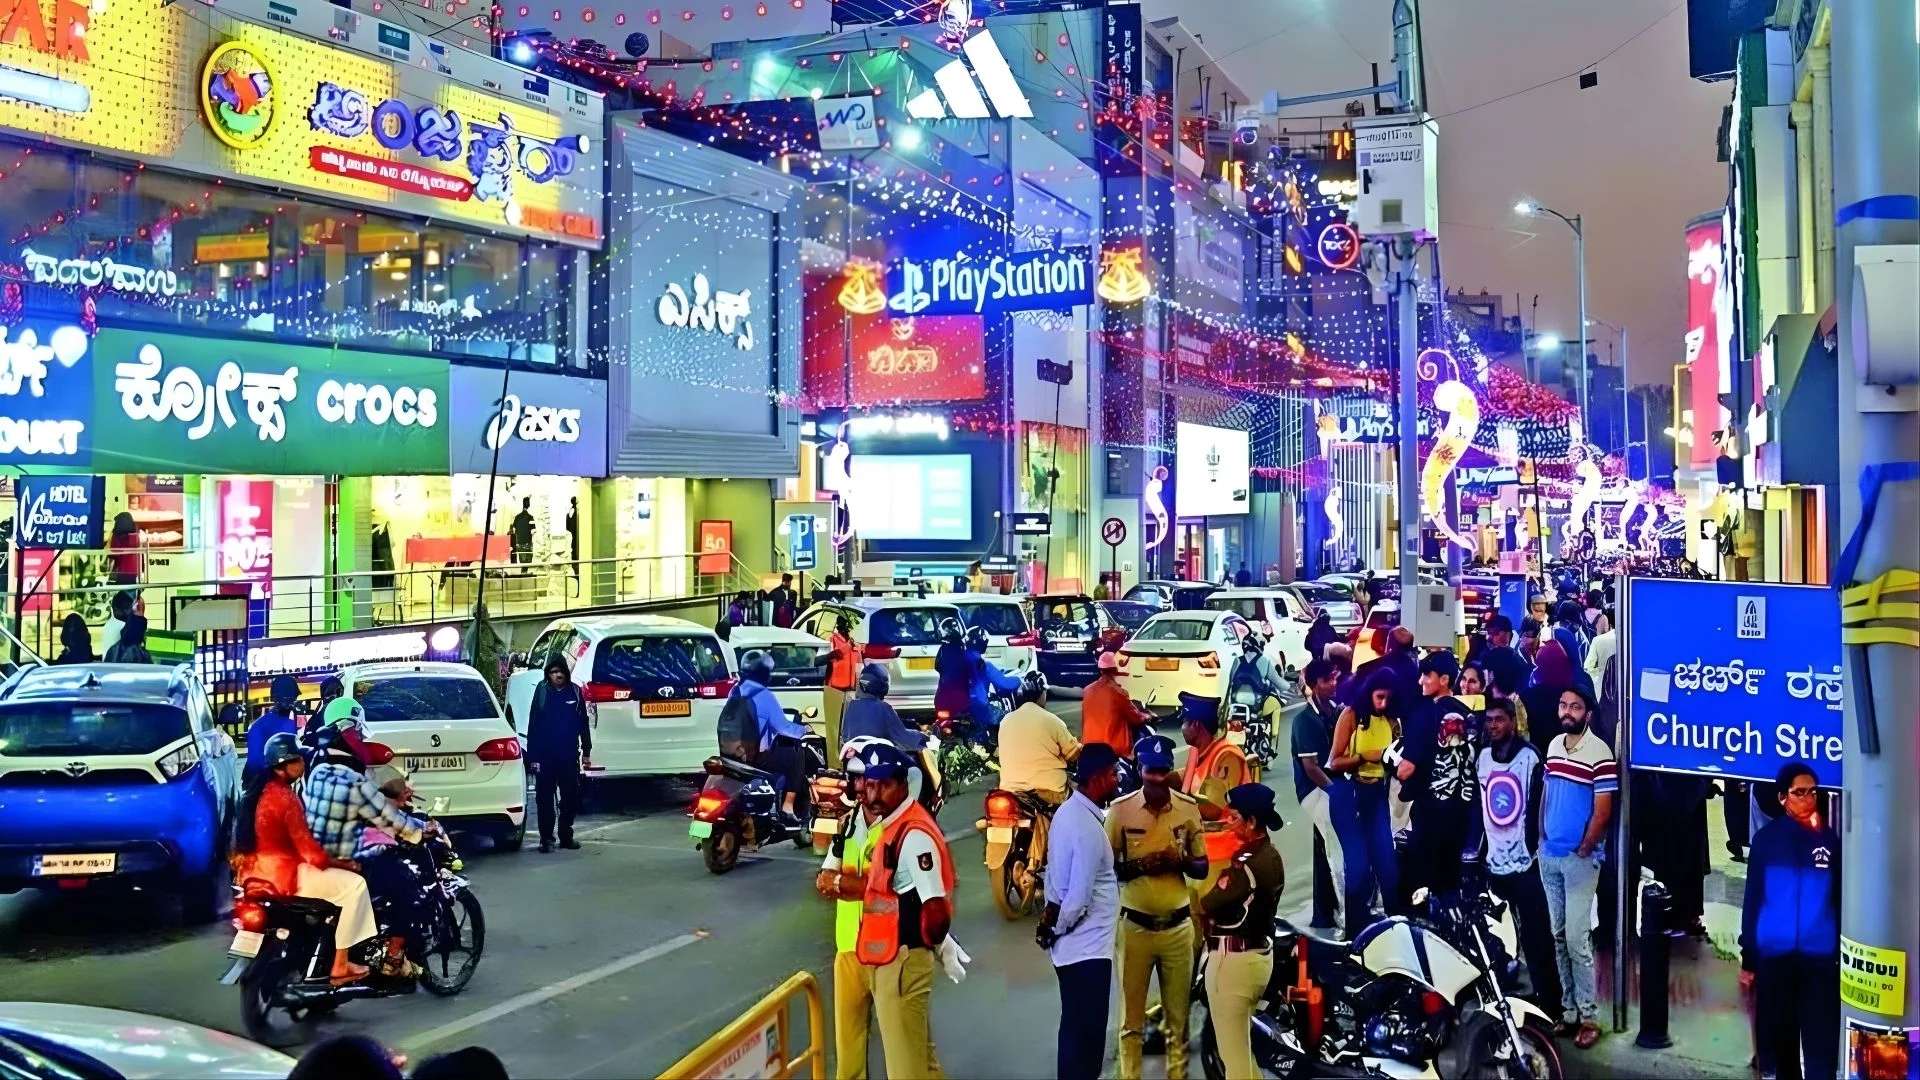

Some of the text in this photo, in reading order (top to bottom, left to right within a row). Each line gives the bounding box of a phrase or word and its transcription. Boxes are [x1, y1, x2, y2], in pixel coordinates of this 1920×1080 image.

[932, 253, 1086, 312] PlayStation
[317, 378, 438, 428] crocs
[797, 520, 810, 549] P
[1647, 712, 1843, 762] Church Stre
